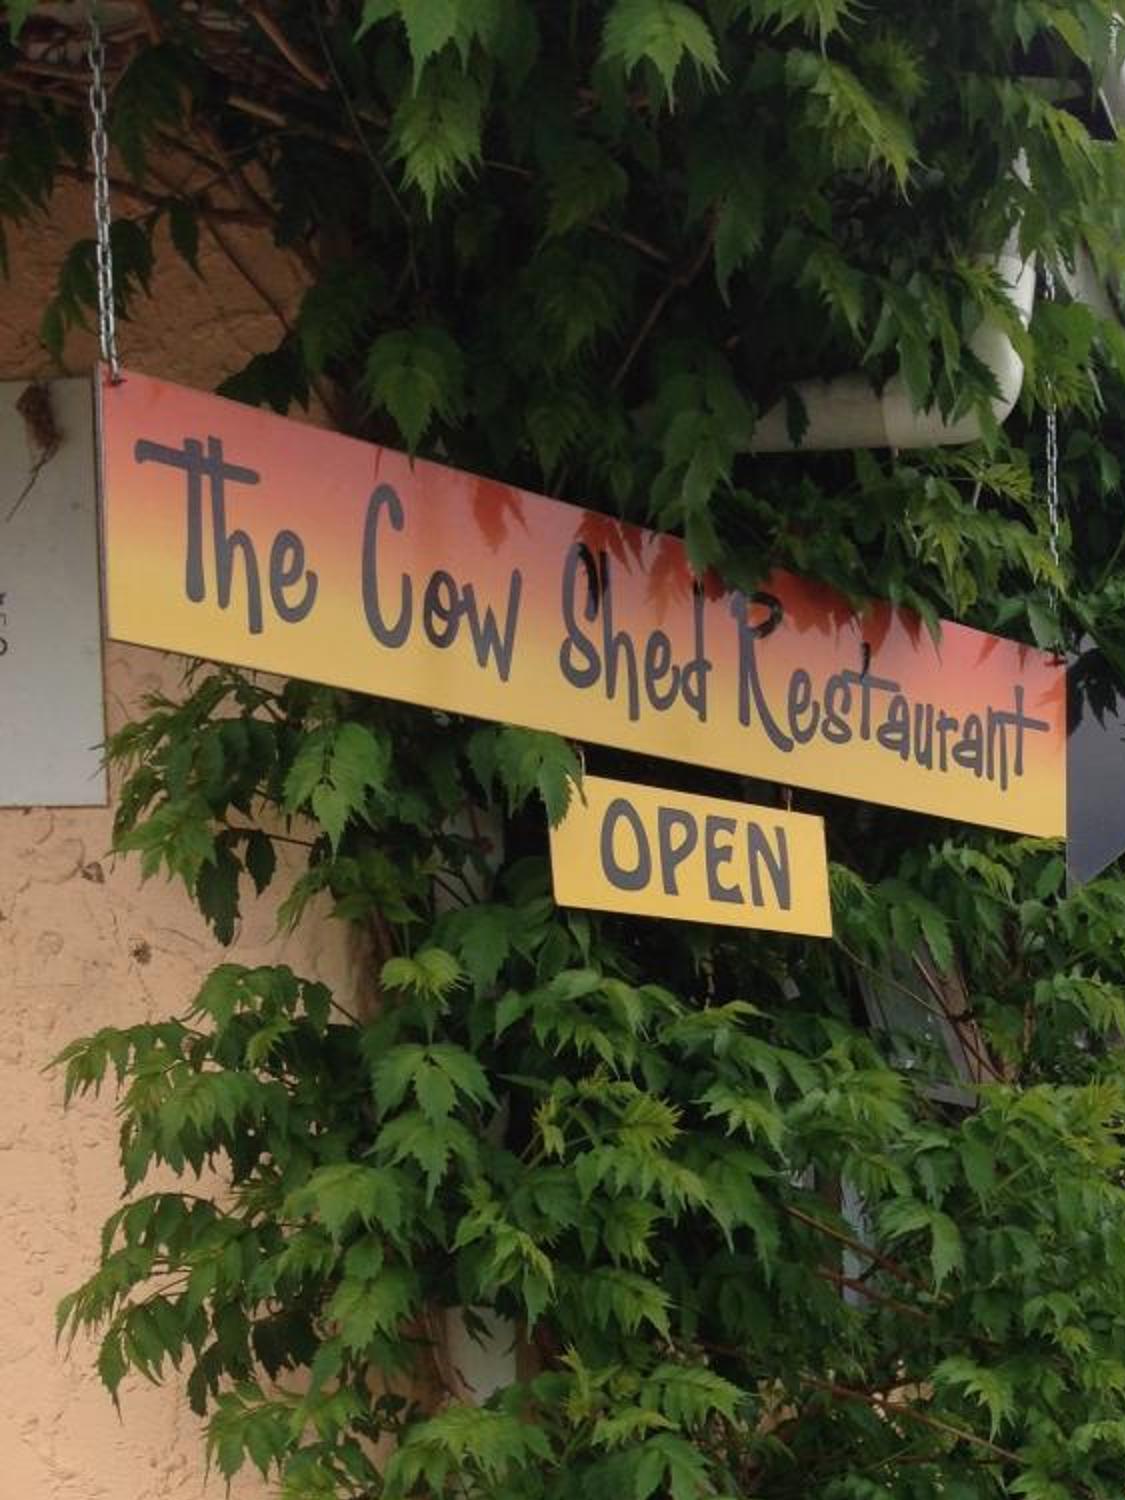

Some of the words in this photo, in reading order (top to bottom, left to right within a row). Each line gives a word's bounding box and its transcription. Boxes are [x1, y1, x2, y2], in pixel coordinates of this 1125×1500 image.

[135, 436, 317, 633] The
[363, 483, 522, 682] Cow
[560, 541, 712, 722] Shed
[729, 590, 1051, 791] Restaurant
[600, 797, 792, 911] OPEN
